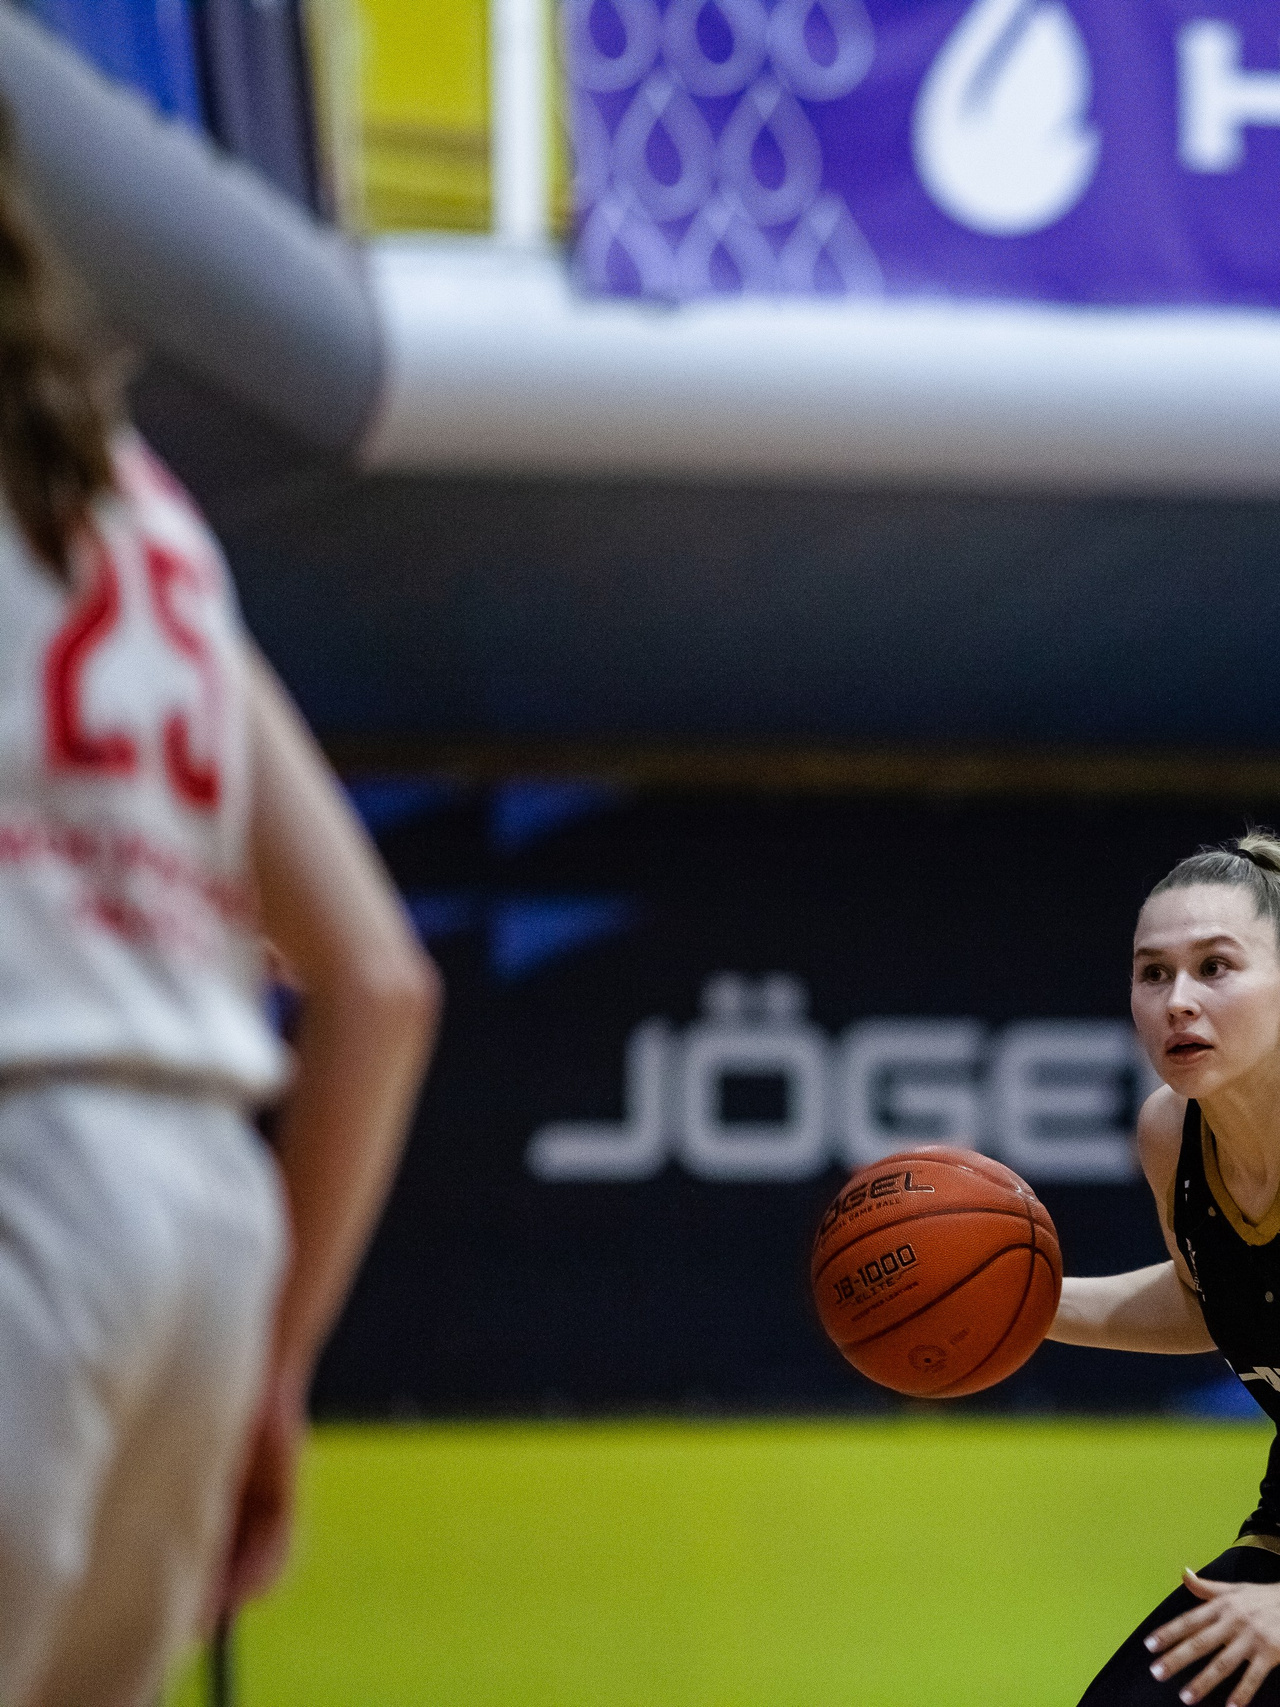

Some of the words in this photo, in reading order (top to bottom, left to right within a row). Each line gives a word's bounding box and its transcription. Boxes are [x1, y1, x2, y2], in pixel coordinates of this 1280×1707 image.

[44, 530, 222, 808] 25
[526, 970, 1142, 1182] JÖGE
[833, 1243, 917, 1305] JB-1000
[855, 1277, 896, 1304] ELITE
